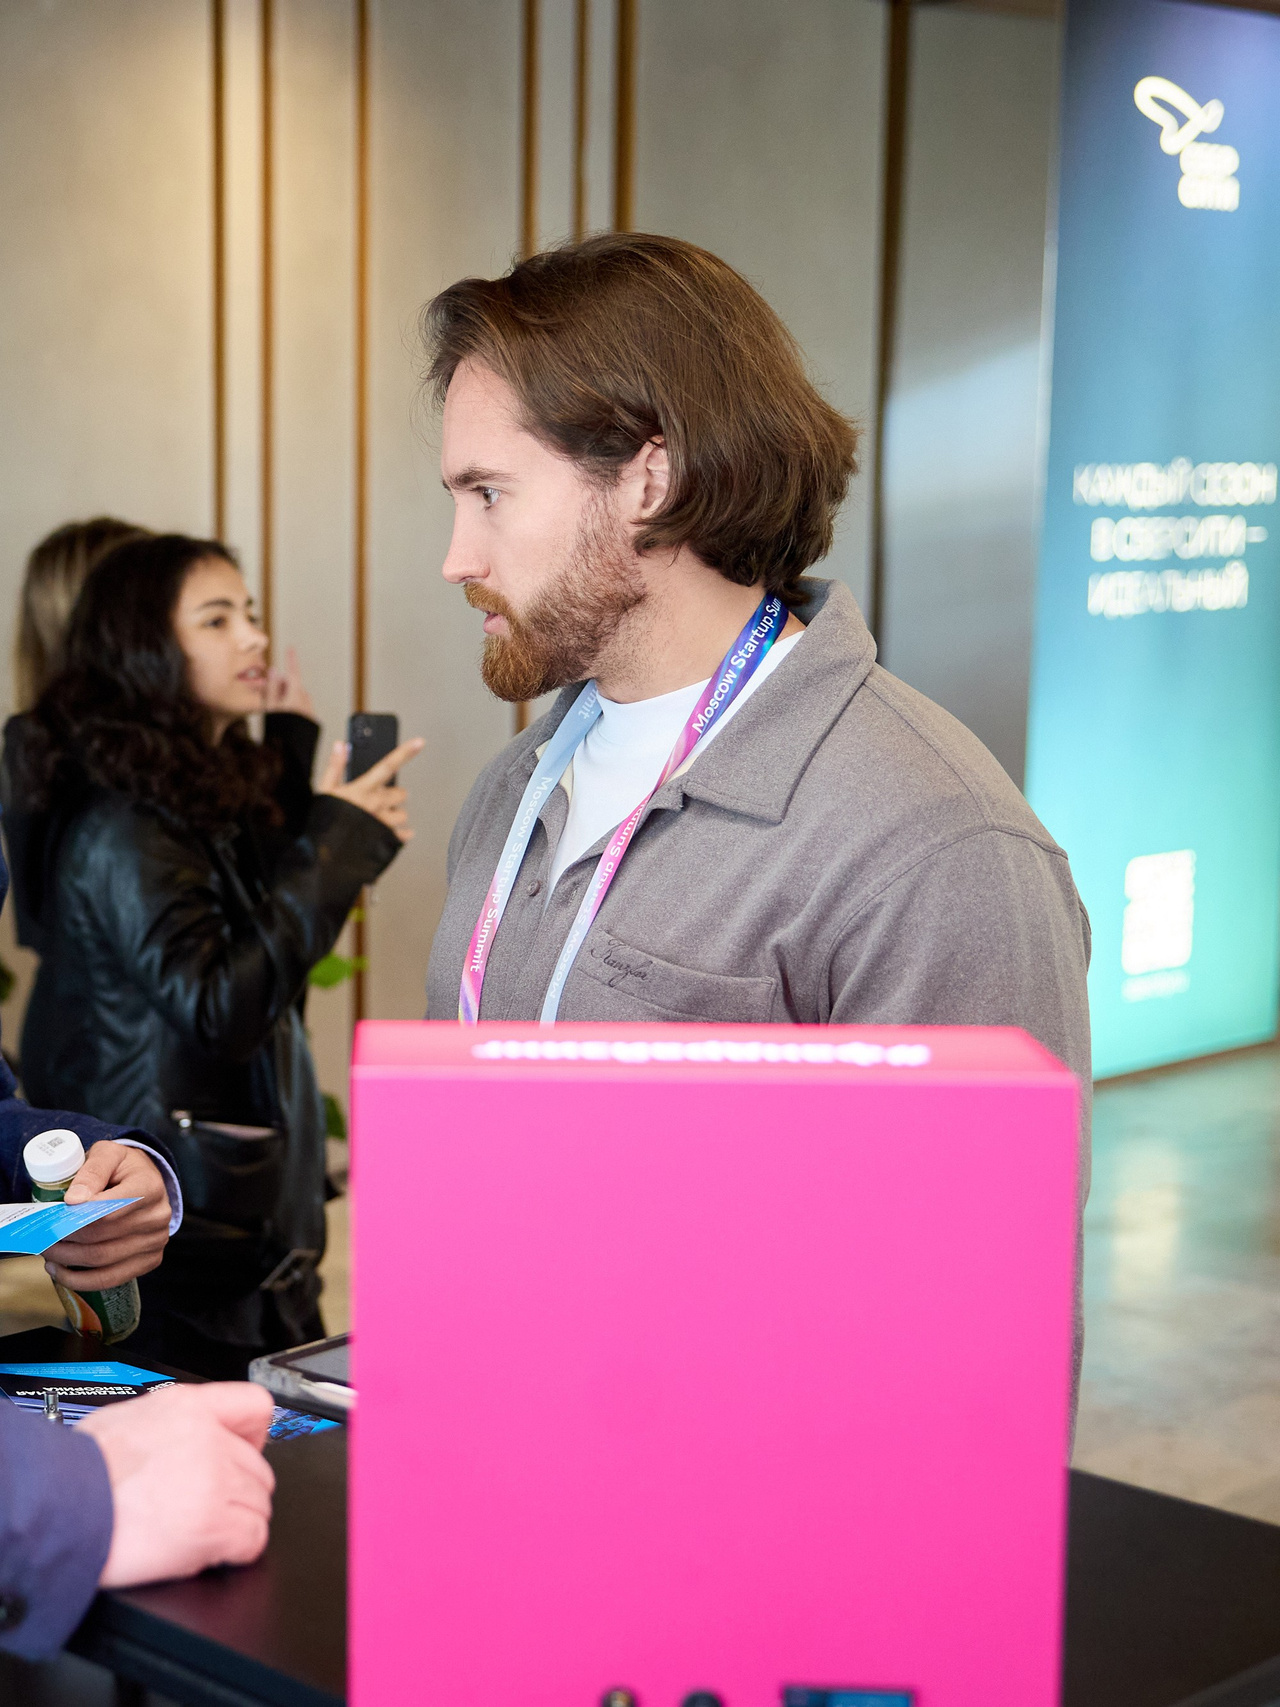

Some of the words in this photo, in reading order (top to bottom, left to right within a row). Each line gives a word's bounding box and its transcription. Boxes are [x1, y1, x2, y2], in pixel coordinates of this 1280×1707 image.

[692, 669, 738, 734] Moscow
[731, 615, 775, 669] Startup
[517, 776, 554, 838] Moscow
[490, 842, 524, 904] Startup
[470, 907, 498, 973] Summit
[548, 930, 580, 999] Moscow
[577, 860, 615, 926] Startup
